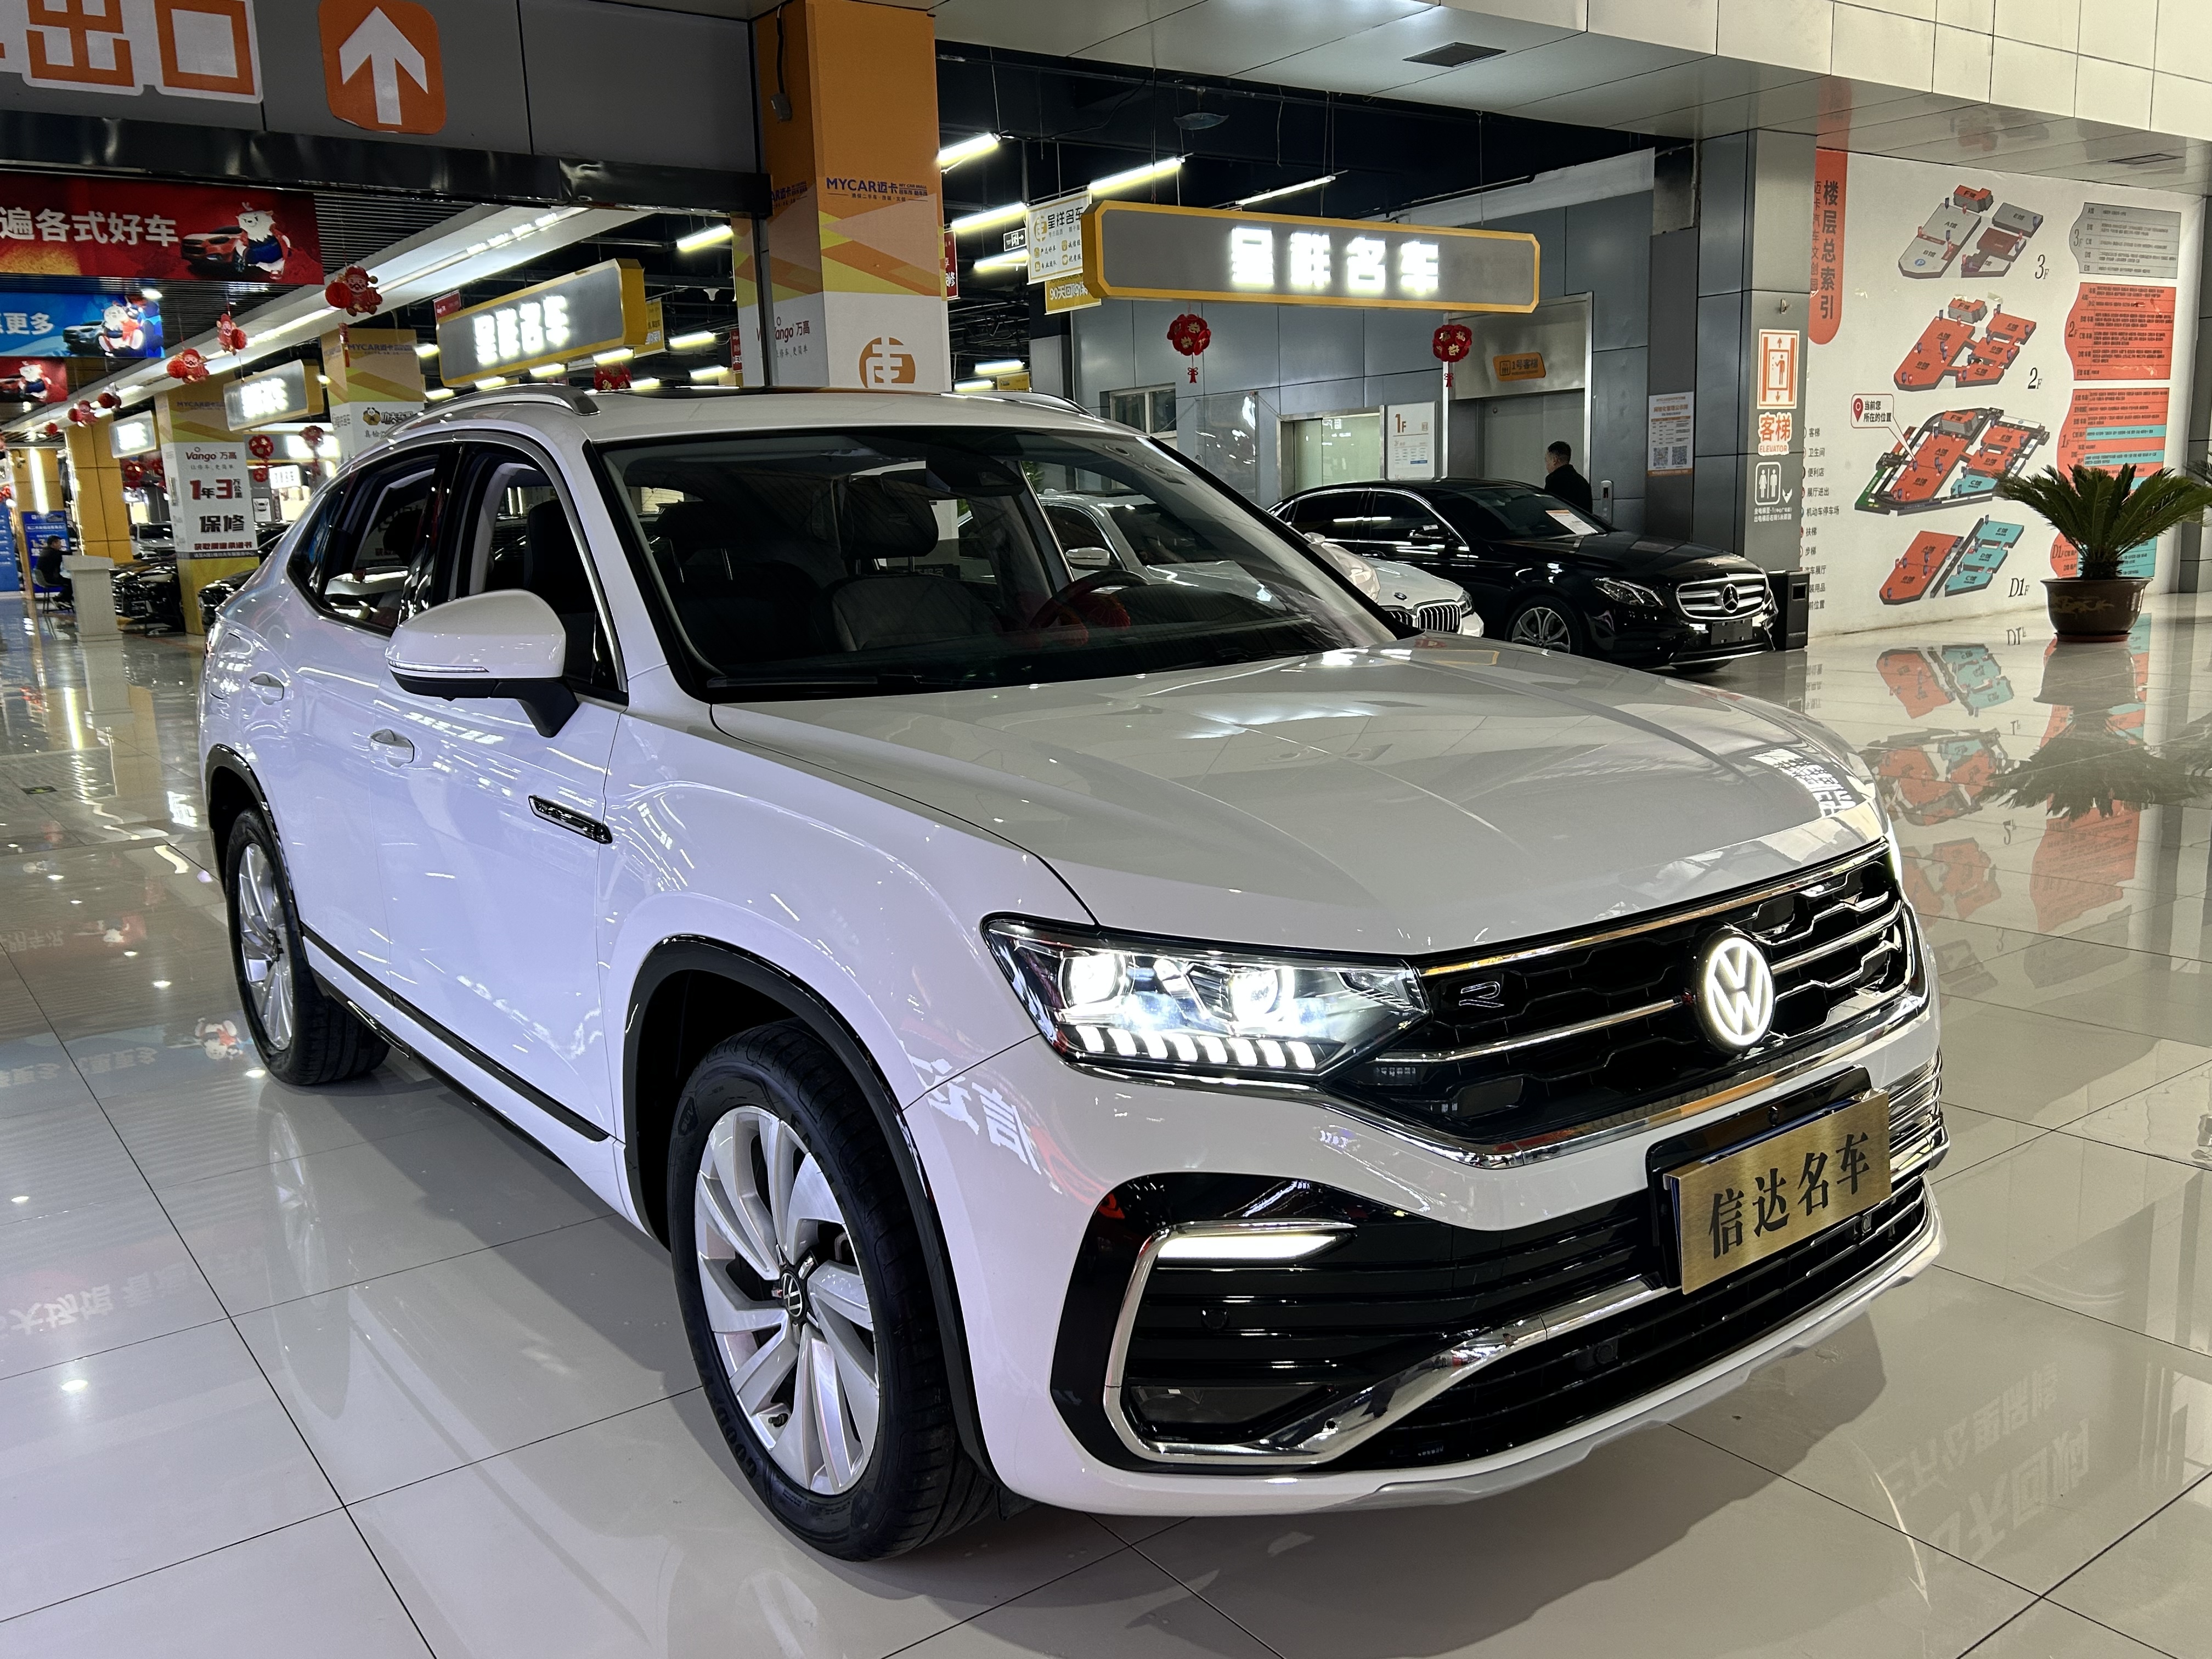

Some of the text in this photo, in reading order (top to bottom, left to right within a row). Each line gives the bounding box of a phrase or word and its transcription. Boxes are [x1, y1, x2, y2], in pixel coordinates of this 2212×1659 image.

[0, 0, 256, 96] 出口
[0, 206, 179, 247] 遍各式好车
[1820, 179, 1839, 320] 楼层总索引
[1050, 281, 1088, 300] 90天回购保
[0, 312, 54, 336] 更多
[774, 327, 794, 343] ango
[1864, 413, 1892, 422] 所在的位置
[1760, 415, 1791, 442] 客梯
[186, 450, 236, 462] Vango 万高
[1759, 444, 1788, 453] ELEVATOR
[200, 515, 244, 533] 保修
[1809, 583, 1826, 593] 装用品
[1809, 600, 1825, 611] 前位置
[1709, 1132, 1870, 1260] 信达名车
